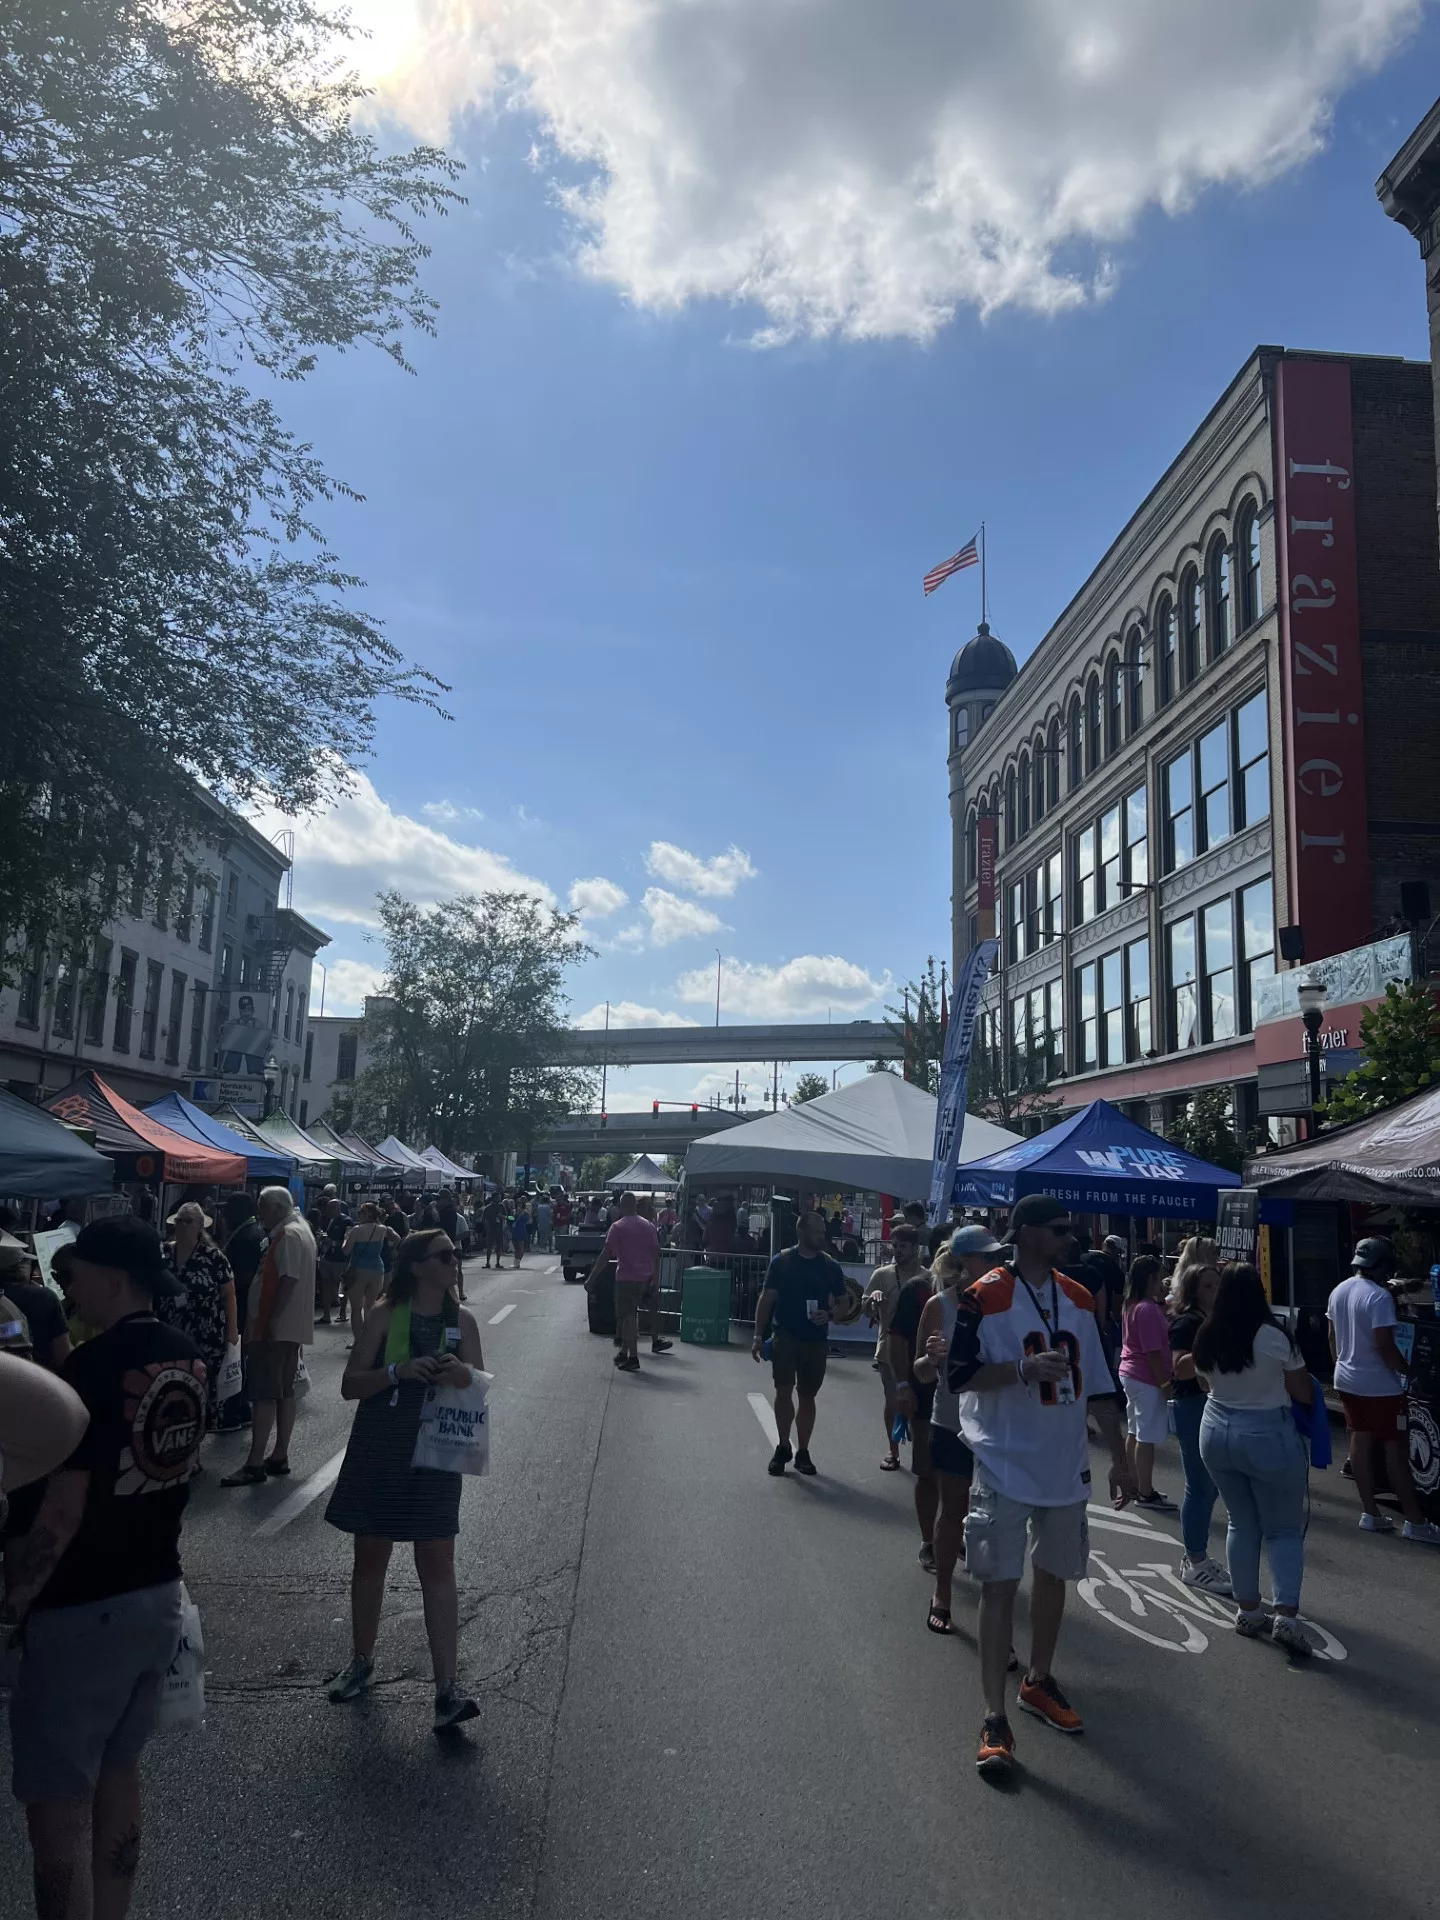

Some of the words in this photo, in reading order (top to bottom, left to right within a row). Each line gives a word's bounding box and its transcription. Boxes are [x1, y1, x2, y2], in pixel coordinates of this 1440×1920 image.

[1289, 457, 1359, 865] frazier
[981, 838, 994, 887] frazier
[960, 955, 987, 1046] THIRSTY?
[1302, 1026, 1347, 1053] fzier
[220, 1082, 252, 1092] Kentucky
[1108, 1146, 1187, 1168] PURE
[1129, 1162, 1185, 1179] TAP
[1042, 1188, 1080, 1201] FRESH
[1086, 1191, 1118, 1203] FROM
[1125, 1193, 1146, 1204] THE
[1151, 1194, 1196, 1208] FAUCET
[1215, 1226, 1254, 1250] BOURBON
[1220, 1248, 1236, 1259] BEHIND
[1237, 1250, 1247, 1261] THE
[151, 1420, 198, 1454] VANS
[438, 1421, 475, 1437] BANK
